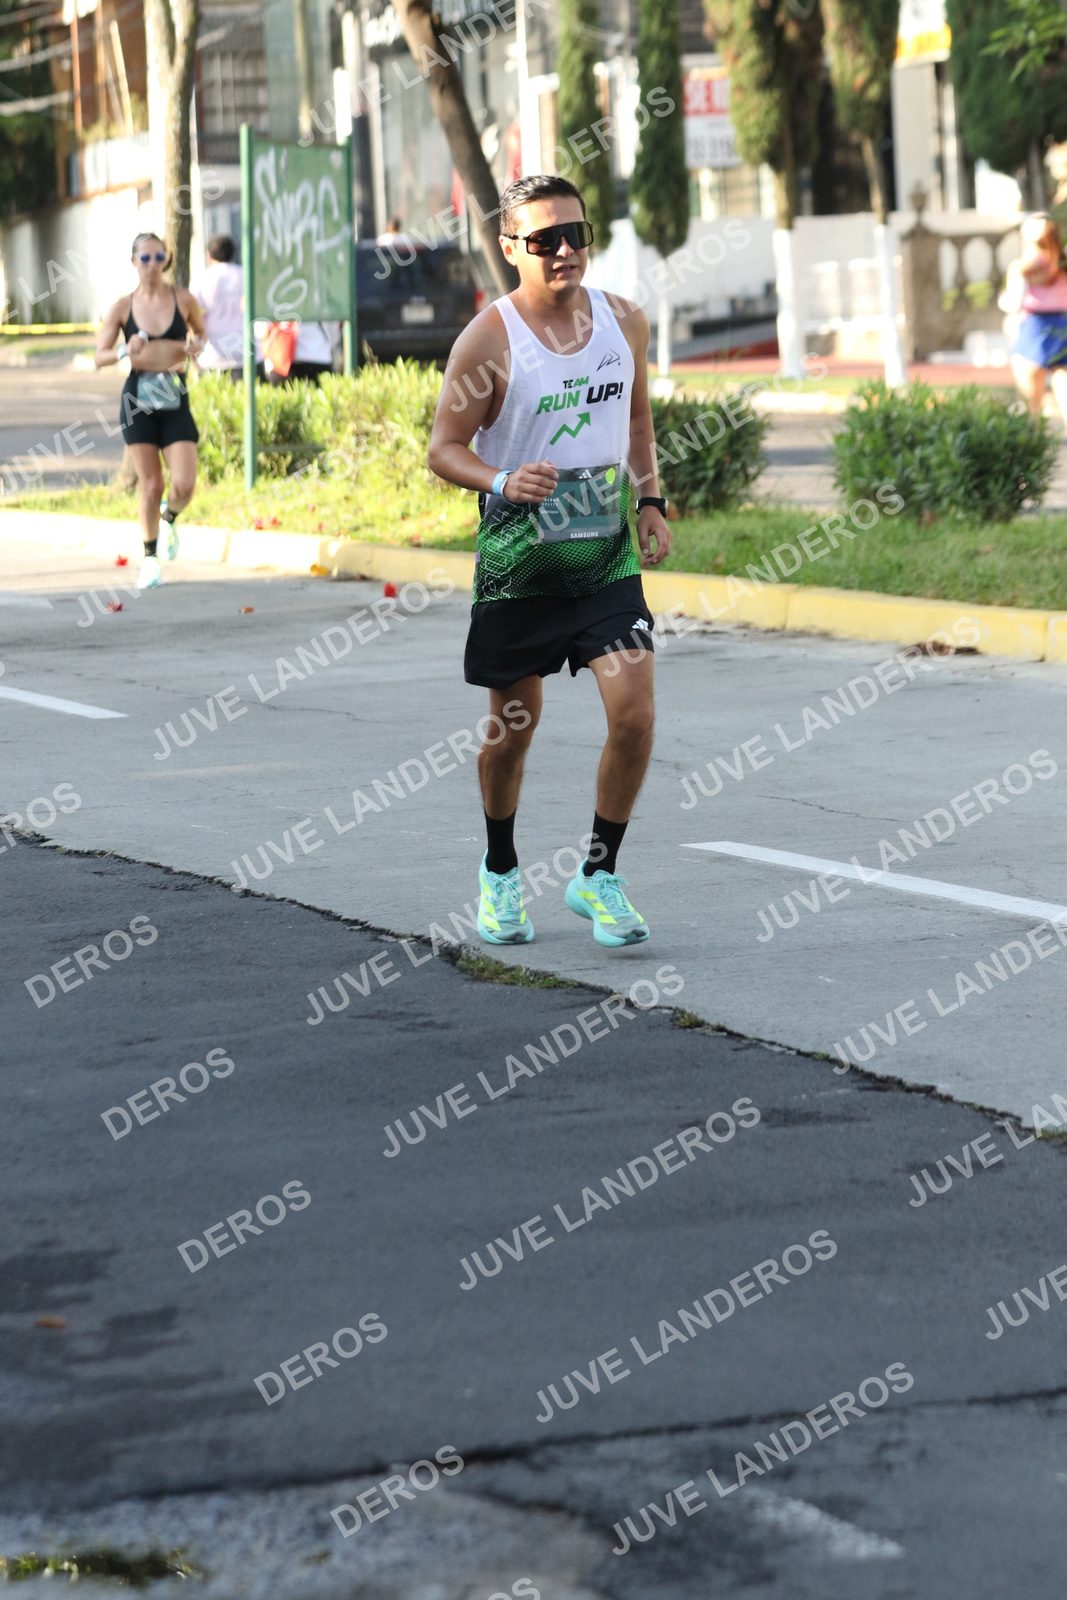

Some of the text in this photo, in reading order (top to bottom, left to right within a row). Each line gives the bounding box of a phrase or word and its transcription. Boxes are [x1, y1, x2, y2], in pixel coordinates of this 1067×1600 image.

[563, 376, 589, 389] TEAM
[536, 382, 624, 415] RUN UP!
